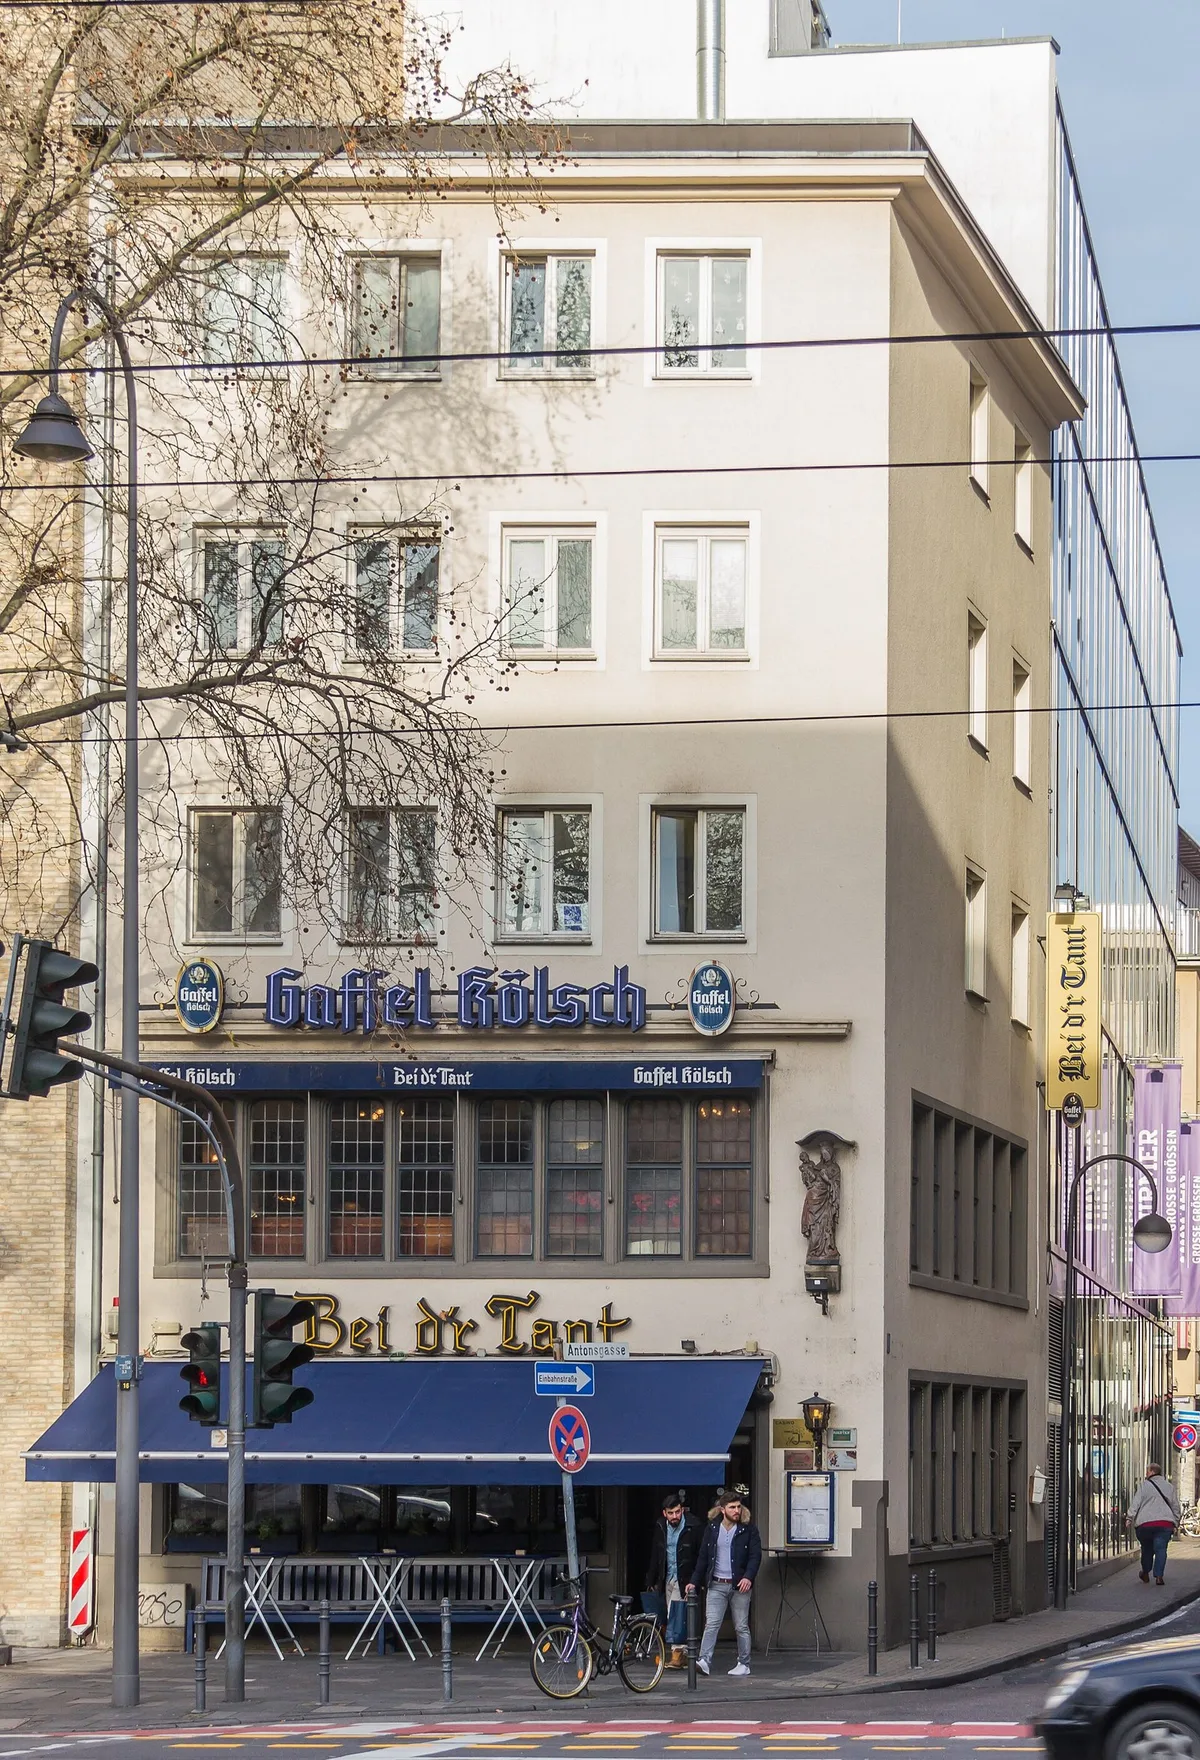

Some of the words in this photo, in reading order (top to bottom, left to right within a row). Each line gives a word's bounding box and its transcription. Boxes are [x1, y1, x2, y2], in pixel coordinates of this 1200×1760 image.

[1060, 924, 1088, 990] Tant
[180, 986, 217, 1003] Gaffel
[265, 966, 437, 1035] Gaffel
[458, 964, 647, 1033] Kölsch
[692, 989, 731, 1006] Gaffel
[186, 1002, 211, 1013] Kölsch
[699, 1004, 723, 1015] Kölsch
[1057, 1031, 1091, 1083] Bei
[185, 1067, 236, 1087] Kölsch
[394, 1067, 421, 1086] Bei
[439, 1067, 474, 1086] Tant
[633, 1066, 677, 1087] Gaffel
[682, 1066, 732, 1086] Kölsch
[1164, 1129, 1177, 1182] GRÖSSEN
[293, 1291, 393, 1352] Bei
[485, 1290, 632, 1351] Tant
[567, 1344, 626, 1358] Antonsgasse
[539, 1374, 578, 1384] Einbahnstraße
